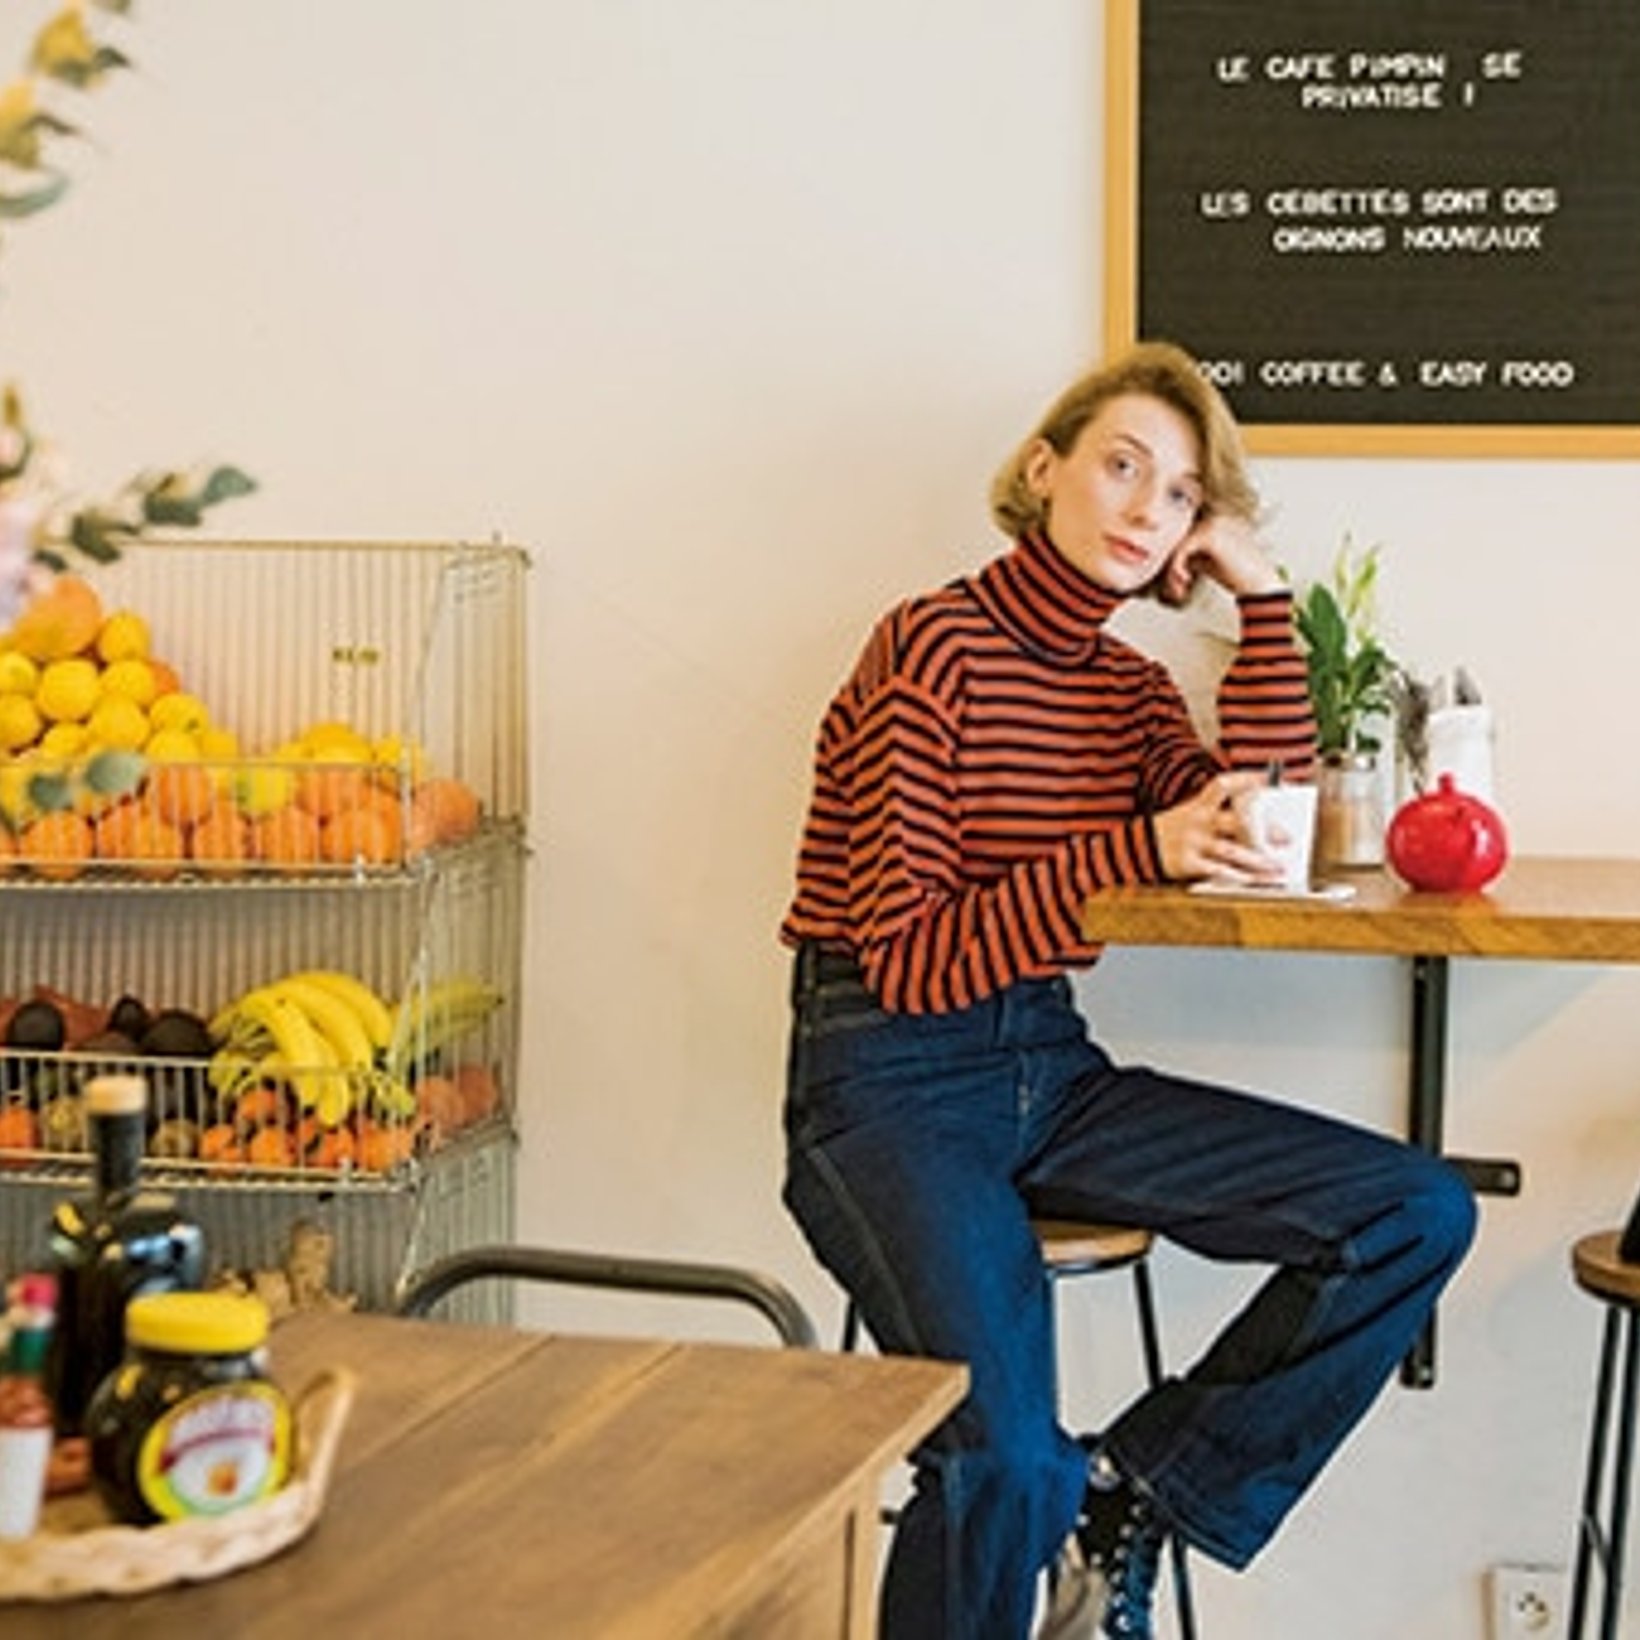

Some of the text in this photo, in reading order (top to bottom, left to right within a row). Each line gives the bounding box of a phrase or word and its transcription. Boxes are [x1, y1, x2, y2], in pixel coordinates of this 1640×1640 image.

[1217, 56, 1249, 82] LE
[1482, 51, 1522, 78] SE
[1301, 82, 1442, 108] PRIVATISE
[1421, 189, 1489, 215] SONT
[1502, 187, 1559, 215] DES
[1402, 225, 1542, 251] NOUVEAUX
[1259, 360, 1364, 387] COFFEE
[1419, 360, 1488, 387] EASY
[1501, 360, 1576, 387] FOOD
